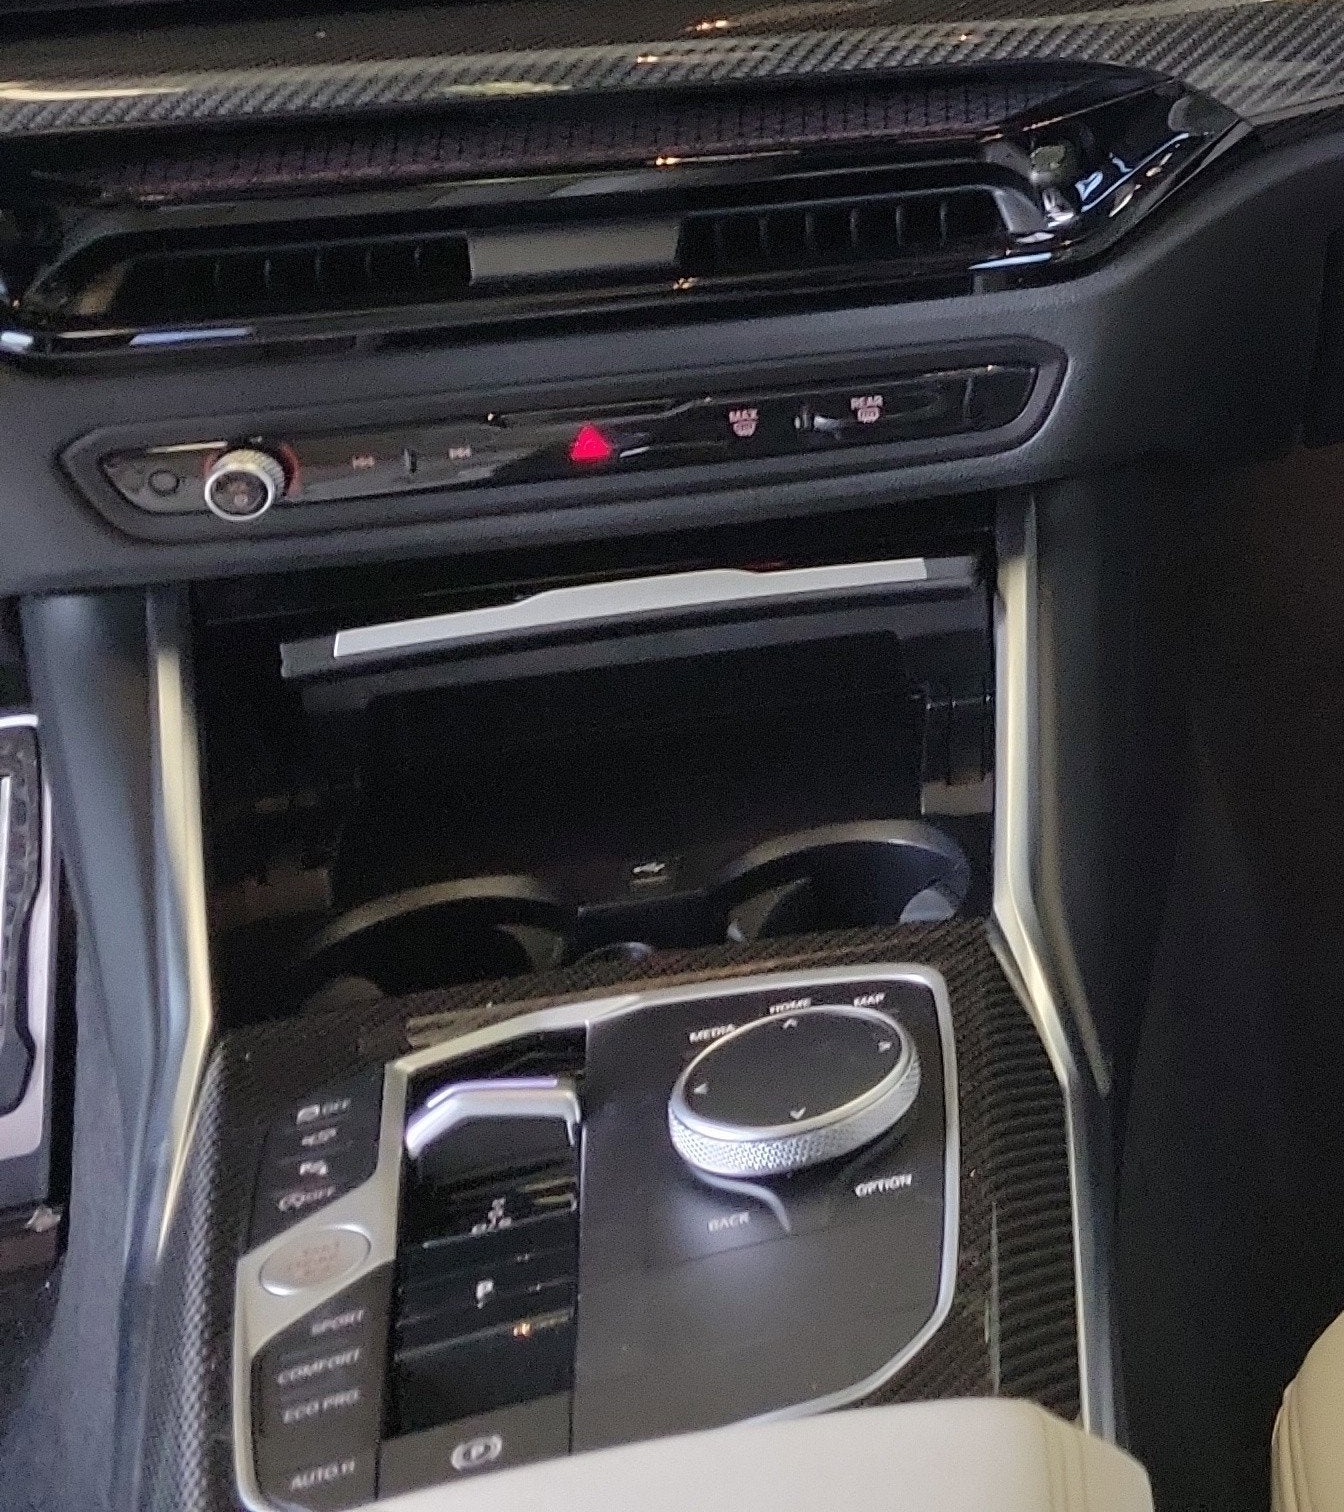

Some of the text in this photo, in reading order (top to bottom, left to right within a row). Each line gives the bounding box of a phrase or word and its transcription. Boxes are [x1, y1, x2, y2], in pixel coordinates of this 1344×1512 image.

[728, 408, 758, 424] MAX
[689, 1023, 737, 1044] MEDIA
[854, 1173, 913, 1197] OPTION
[707, 1211, 751, 1232] BACK
